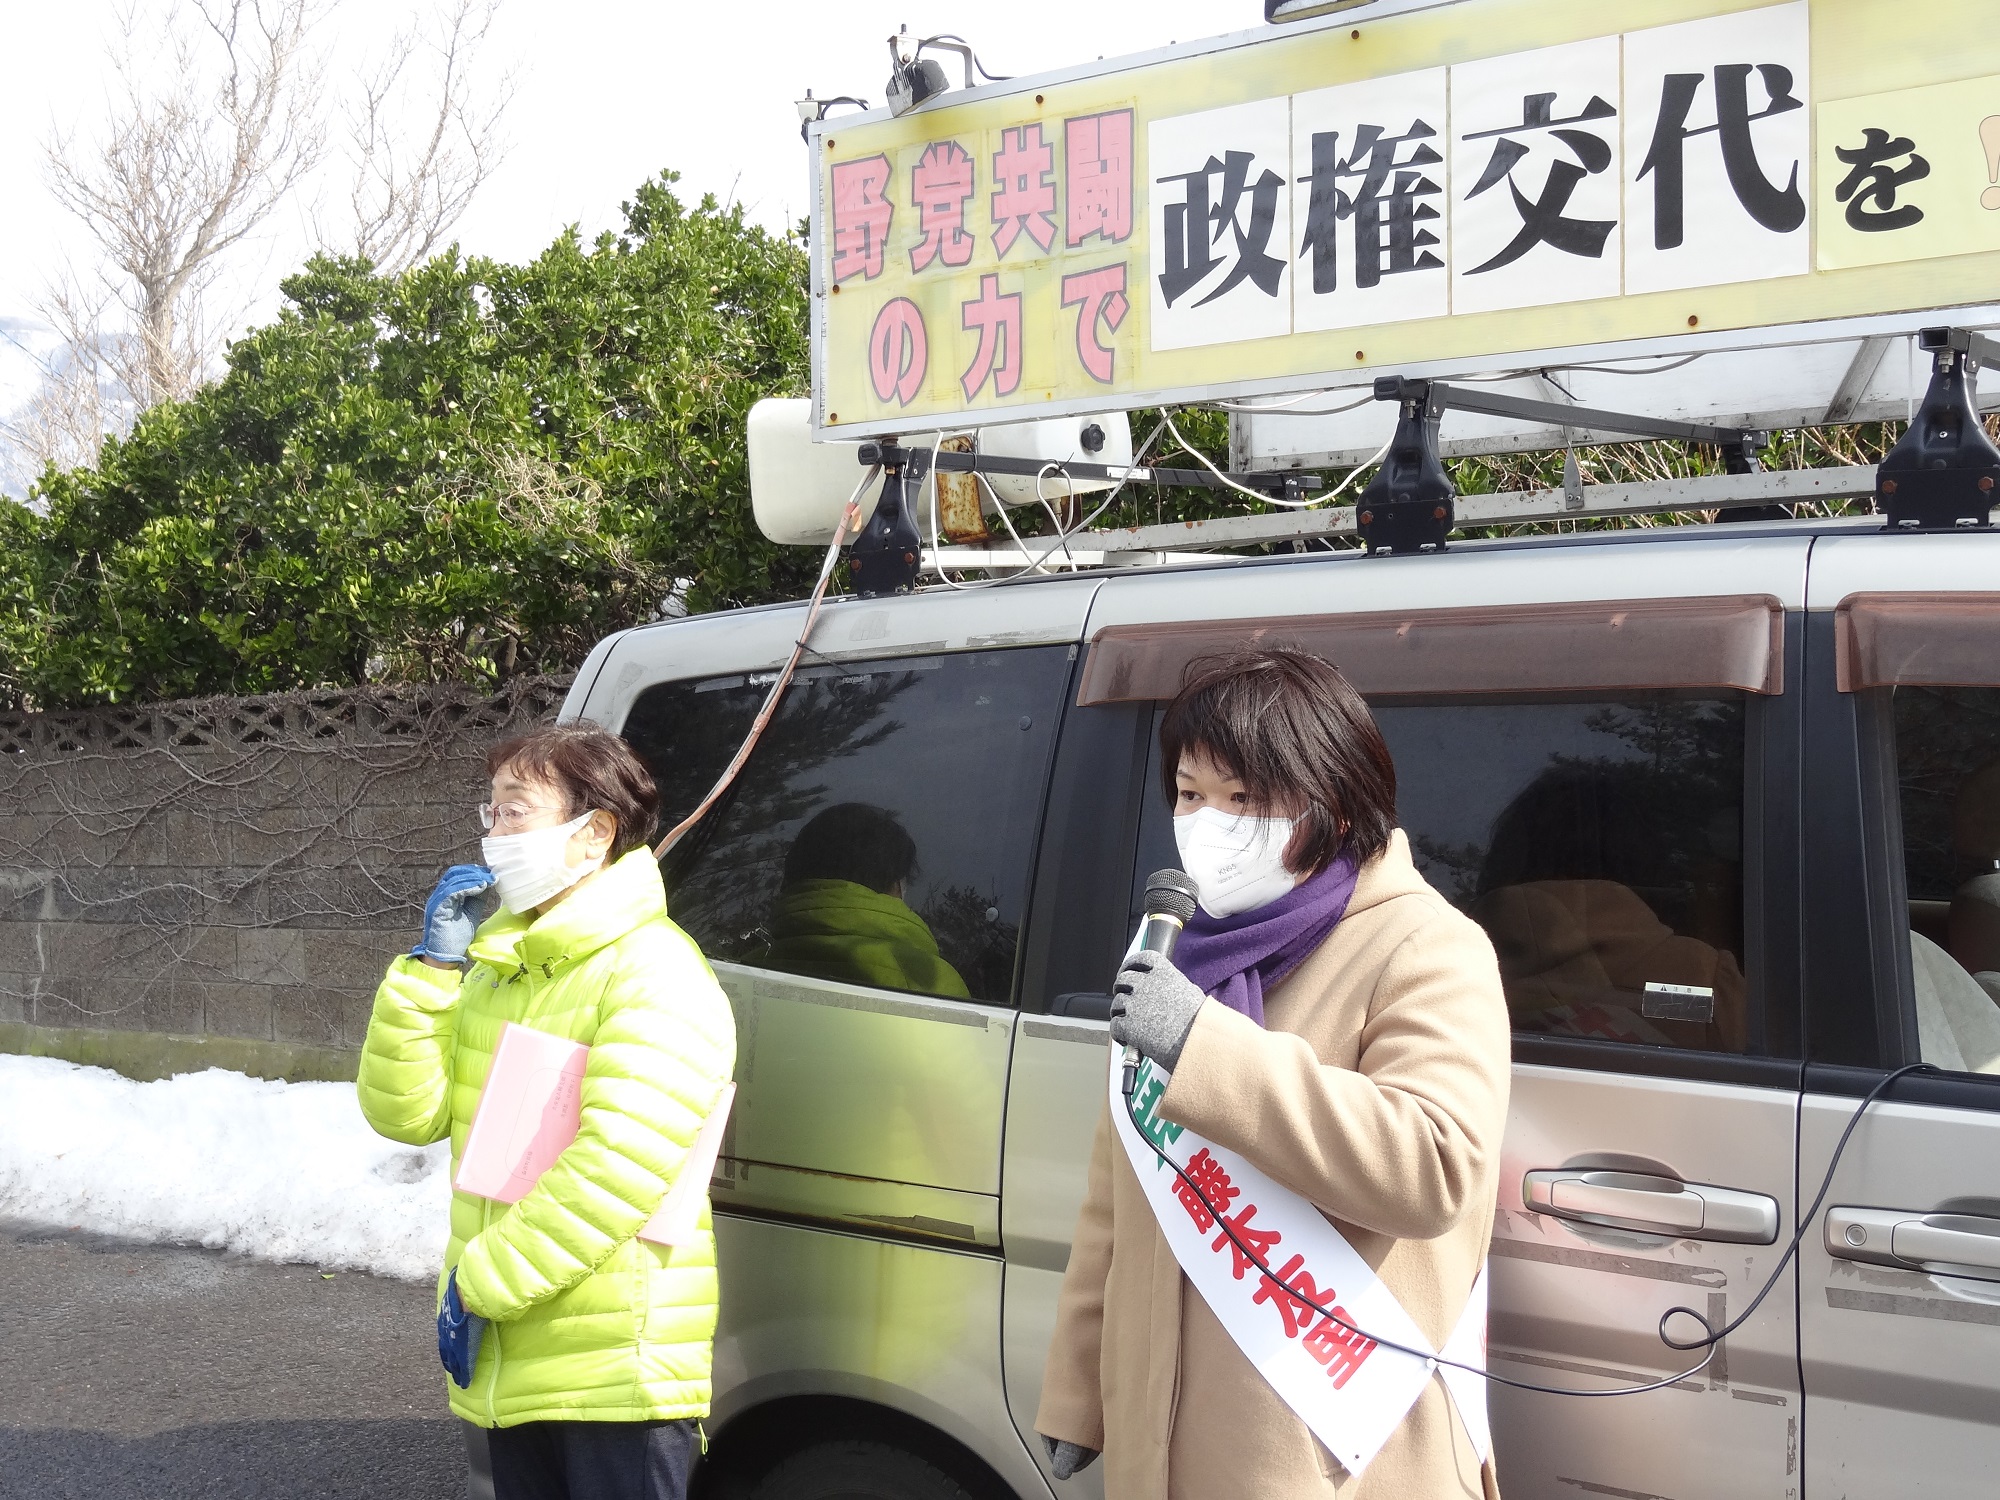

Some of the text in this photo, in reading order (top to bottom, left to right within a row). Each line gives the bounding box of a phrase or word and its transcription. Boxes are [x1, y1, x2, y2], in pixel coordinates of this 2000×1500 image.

[831, 108, 1136, 285] 野党共闘
[868, 262, 1131, 408] の力で
[1171, 1148, 1378, 1390] 藤本友里
